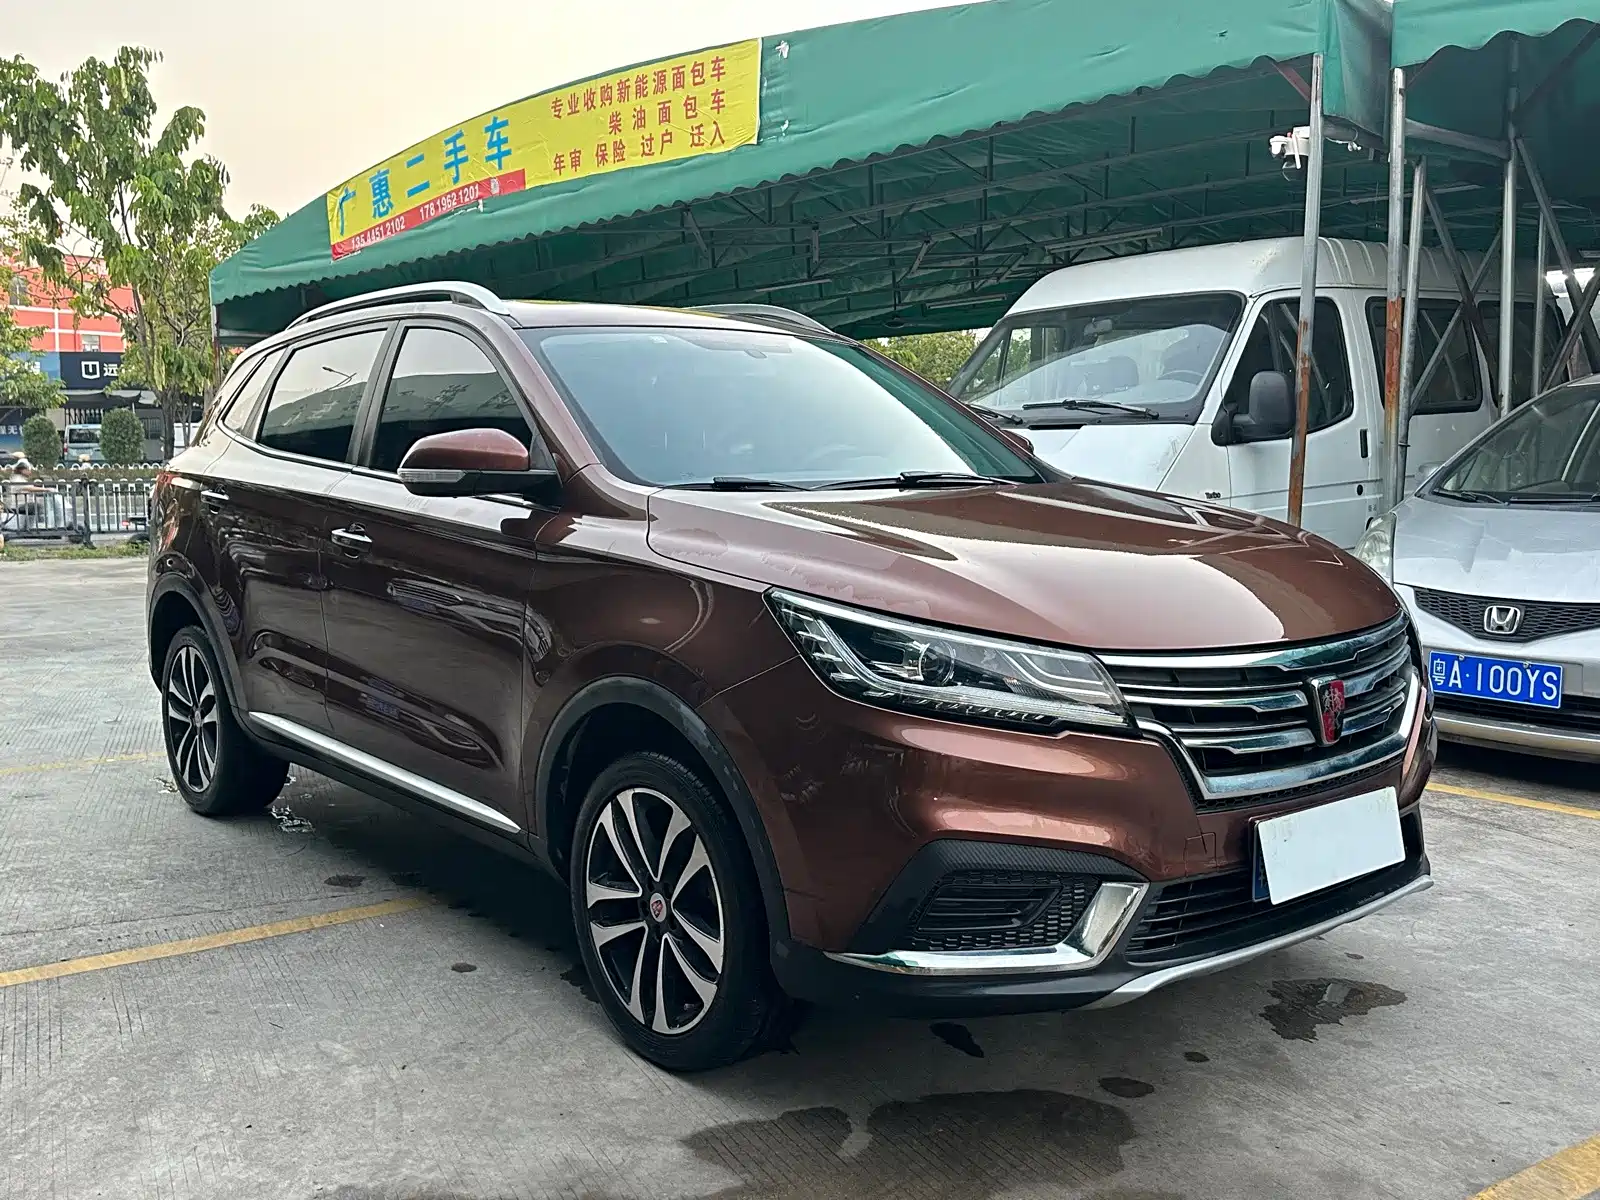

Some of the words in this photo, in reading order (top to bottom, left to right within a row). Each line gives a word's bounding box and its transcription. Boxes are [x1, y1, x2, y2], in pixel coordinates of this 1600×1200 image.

[551, 56, 726, 120] 专业收购新能源面包车
[608, 88, 726, 135] 柴油面包车
[553, 148, 582, 176] 年审
[595, 138, 626, 168] 保险
[640, 129, 673, 158] 过户
[689, 120, 726, 148] 迁入
[336, 115, 512, 237] 广惠二手车
[386, 215, 406, 235] 2102
[419, 202, 435, 221] 178
[437, 191, 457, 213] 1962
[458, 183, 479, 203] 1201
[103, 363, 120, 376] 远
